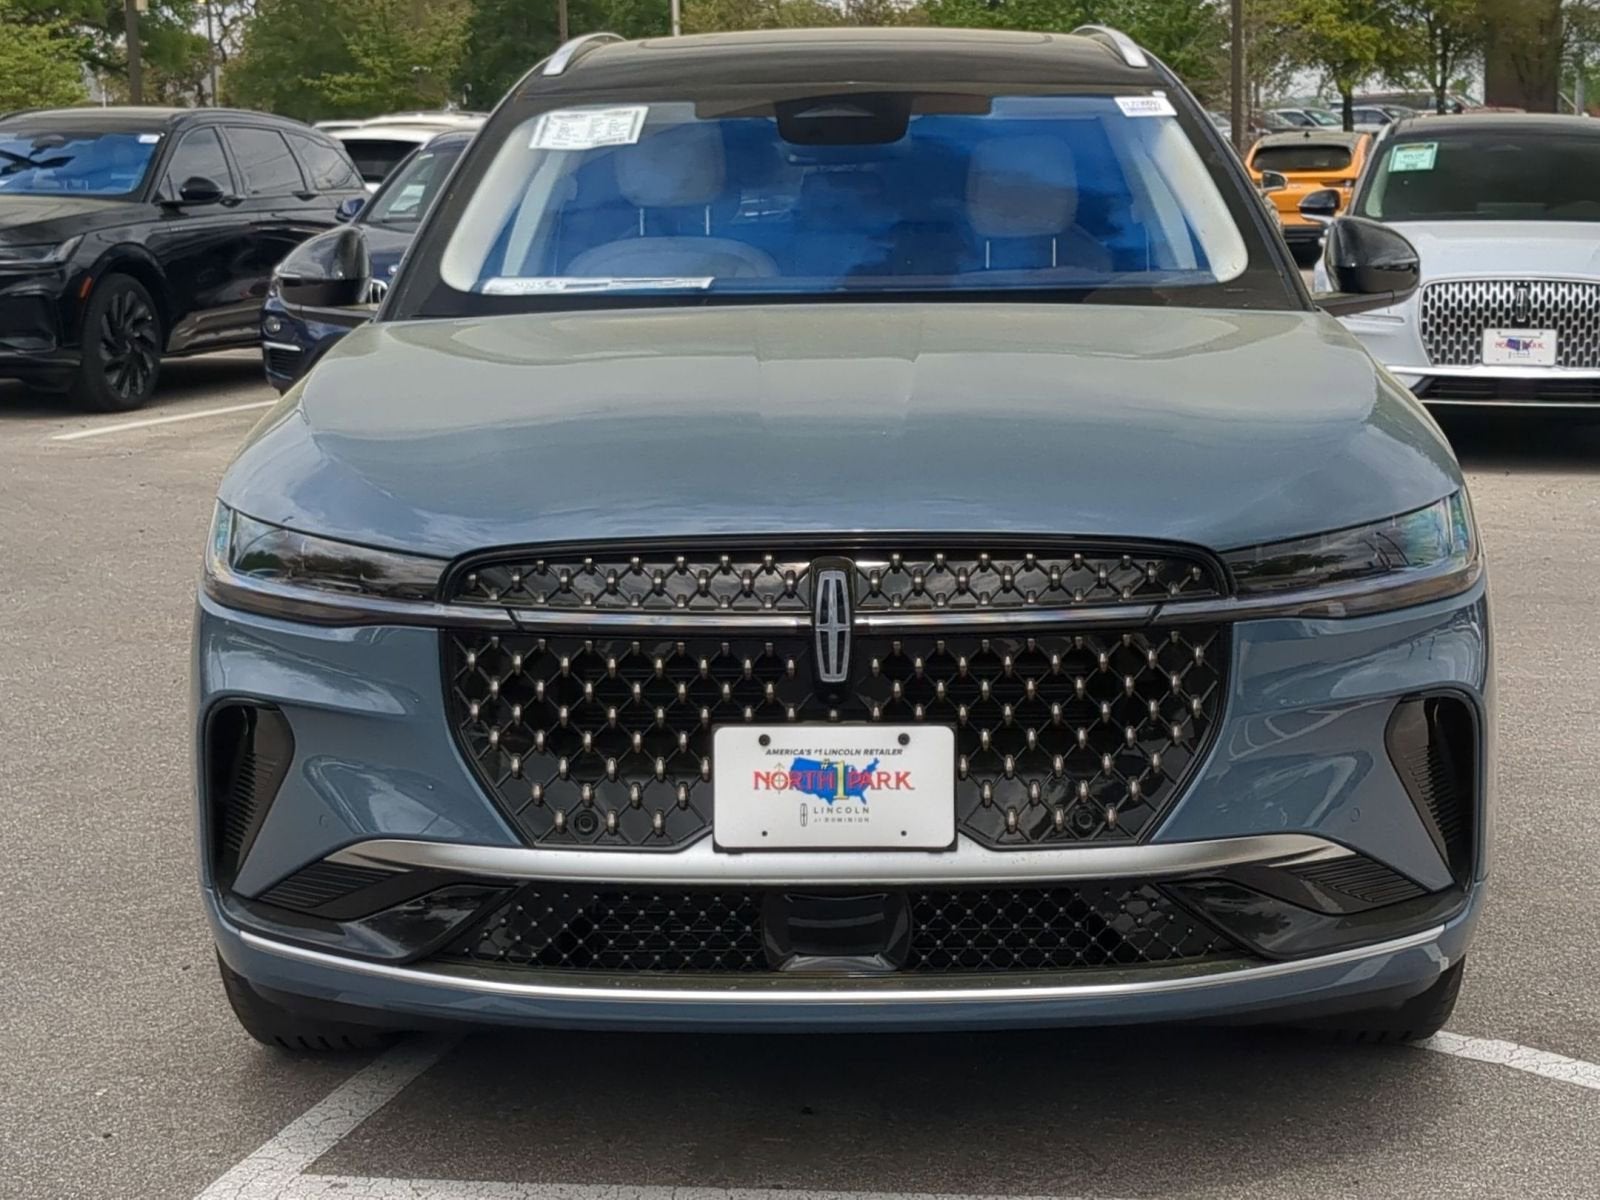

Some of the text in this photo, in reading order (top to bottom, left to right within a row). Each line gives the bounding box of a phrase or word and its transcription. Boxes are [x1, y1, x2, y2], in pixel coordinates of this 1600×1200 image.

[765, 748, 812, 756] AMERICA'S
[823, 748, 862, 756] LINCOLN
[863, 748, 904, 756] RETAILER
[753, 770, 835, 791] NORTH
[847, 770, 916, 791] PARK
[813, 806, 870, 815] LINCOLN
